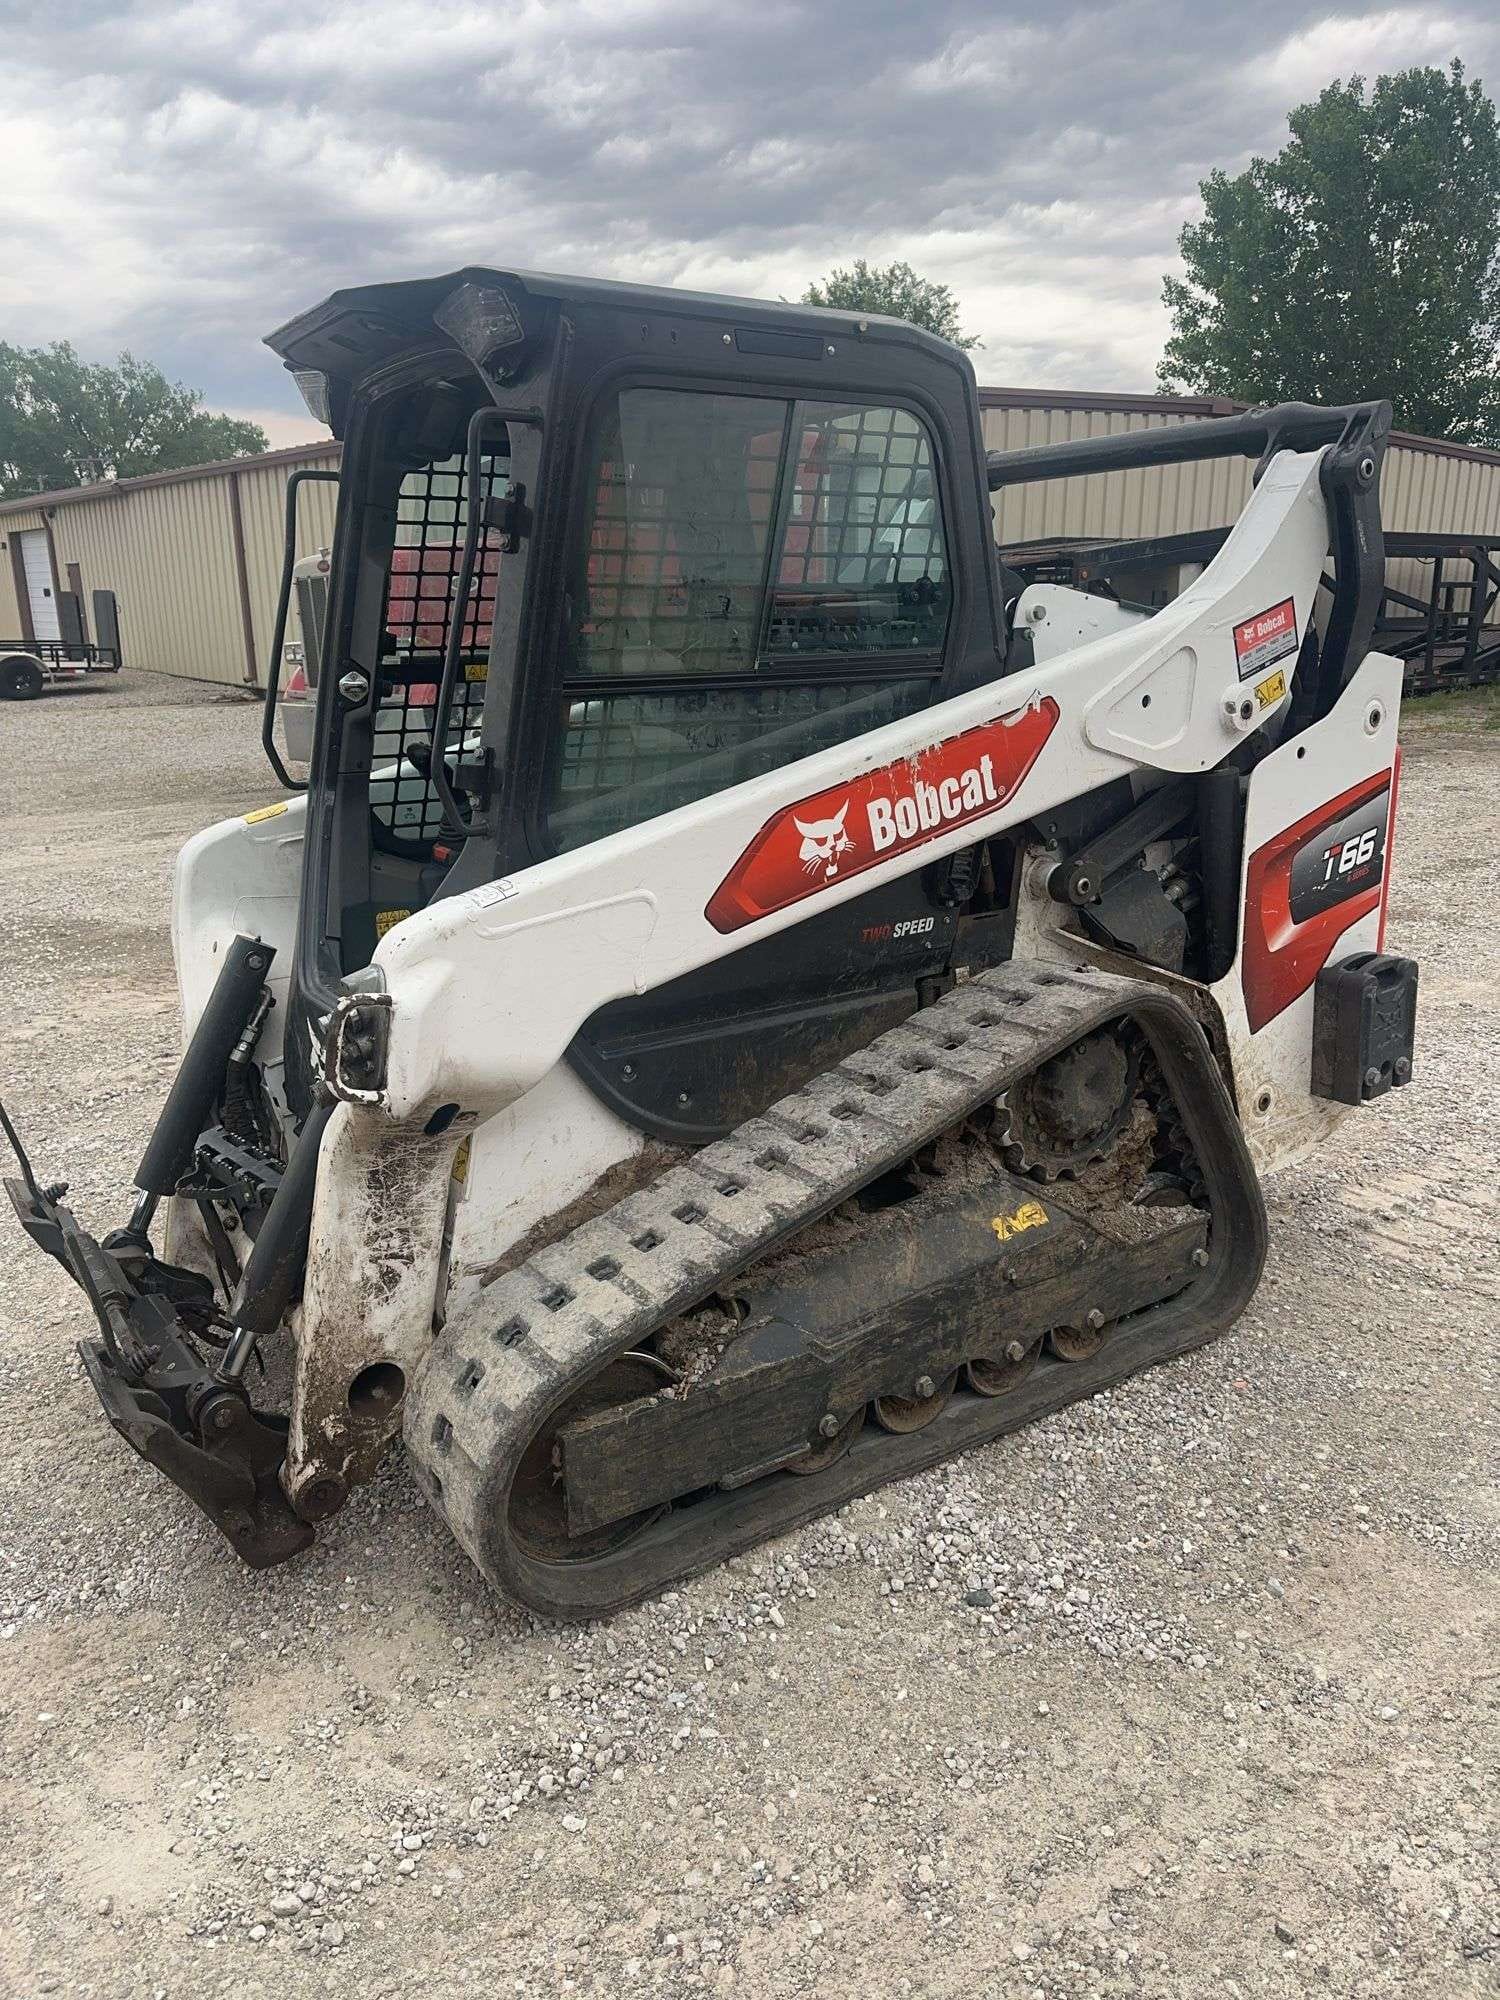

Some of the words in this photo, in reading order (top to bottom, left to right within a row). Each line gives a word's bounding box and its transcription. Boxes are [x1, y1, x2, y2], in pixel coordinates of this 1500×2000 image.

[1257, 611, 1286, 637] Bobcat
[866, 754, 997, 851] Bobcat
[1323, 827, 1378, 881] T66
[893, 917, 934, 938] SPEED
